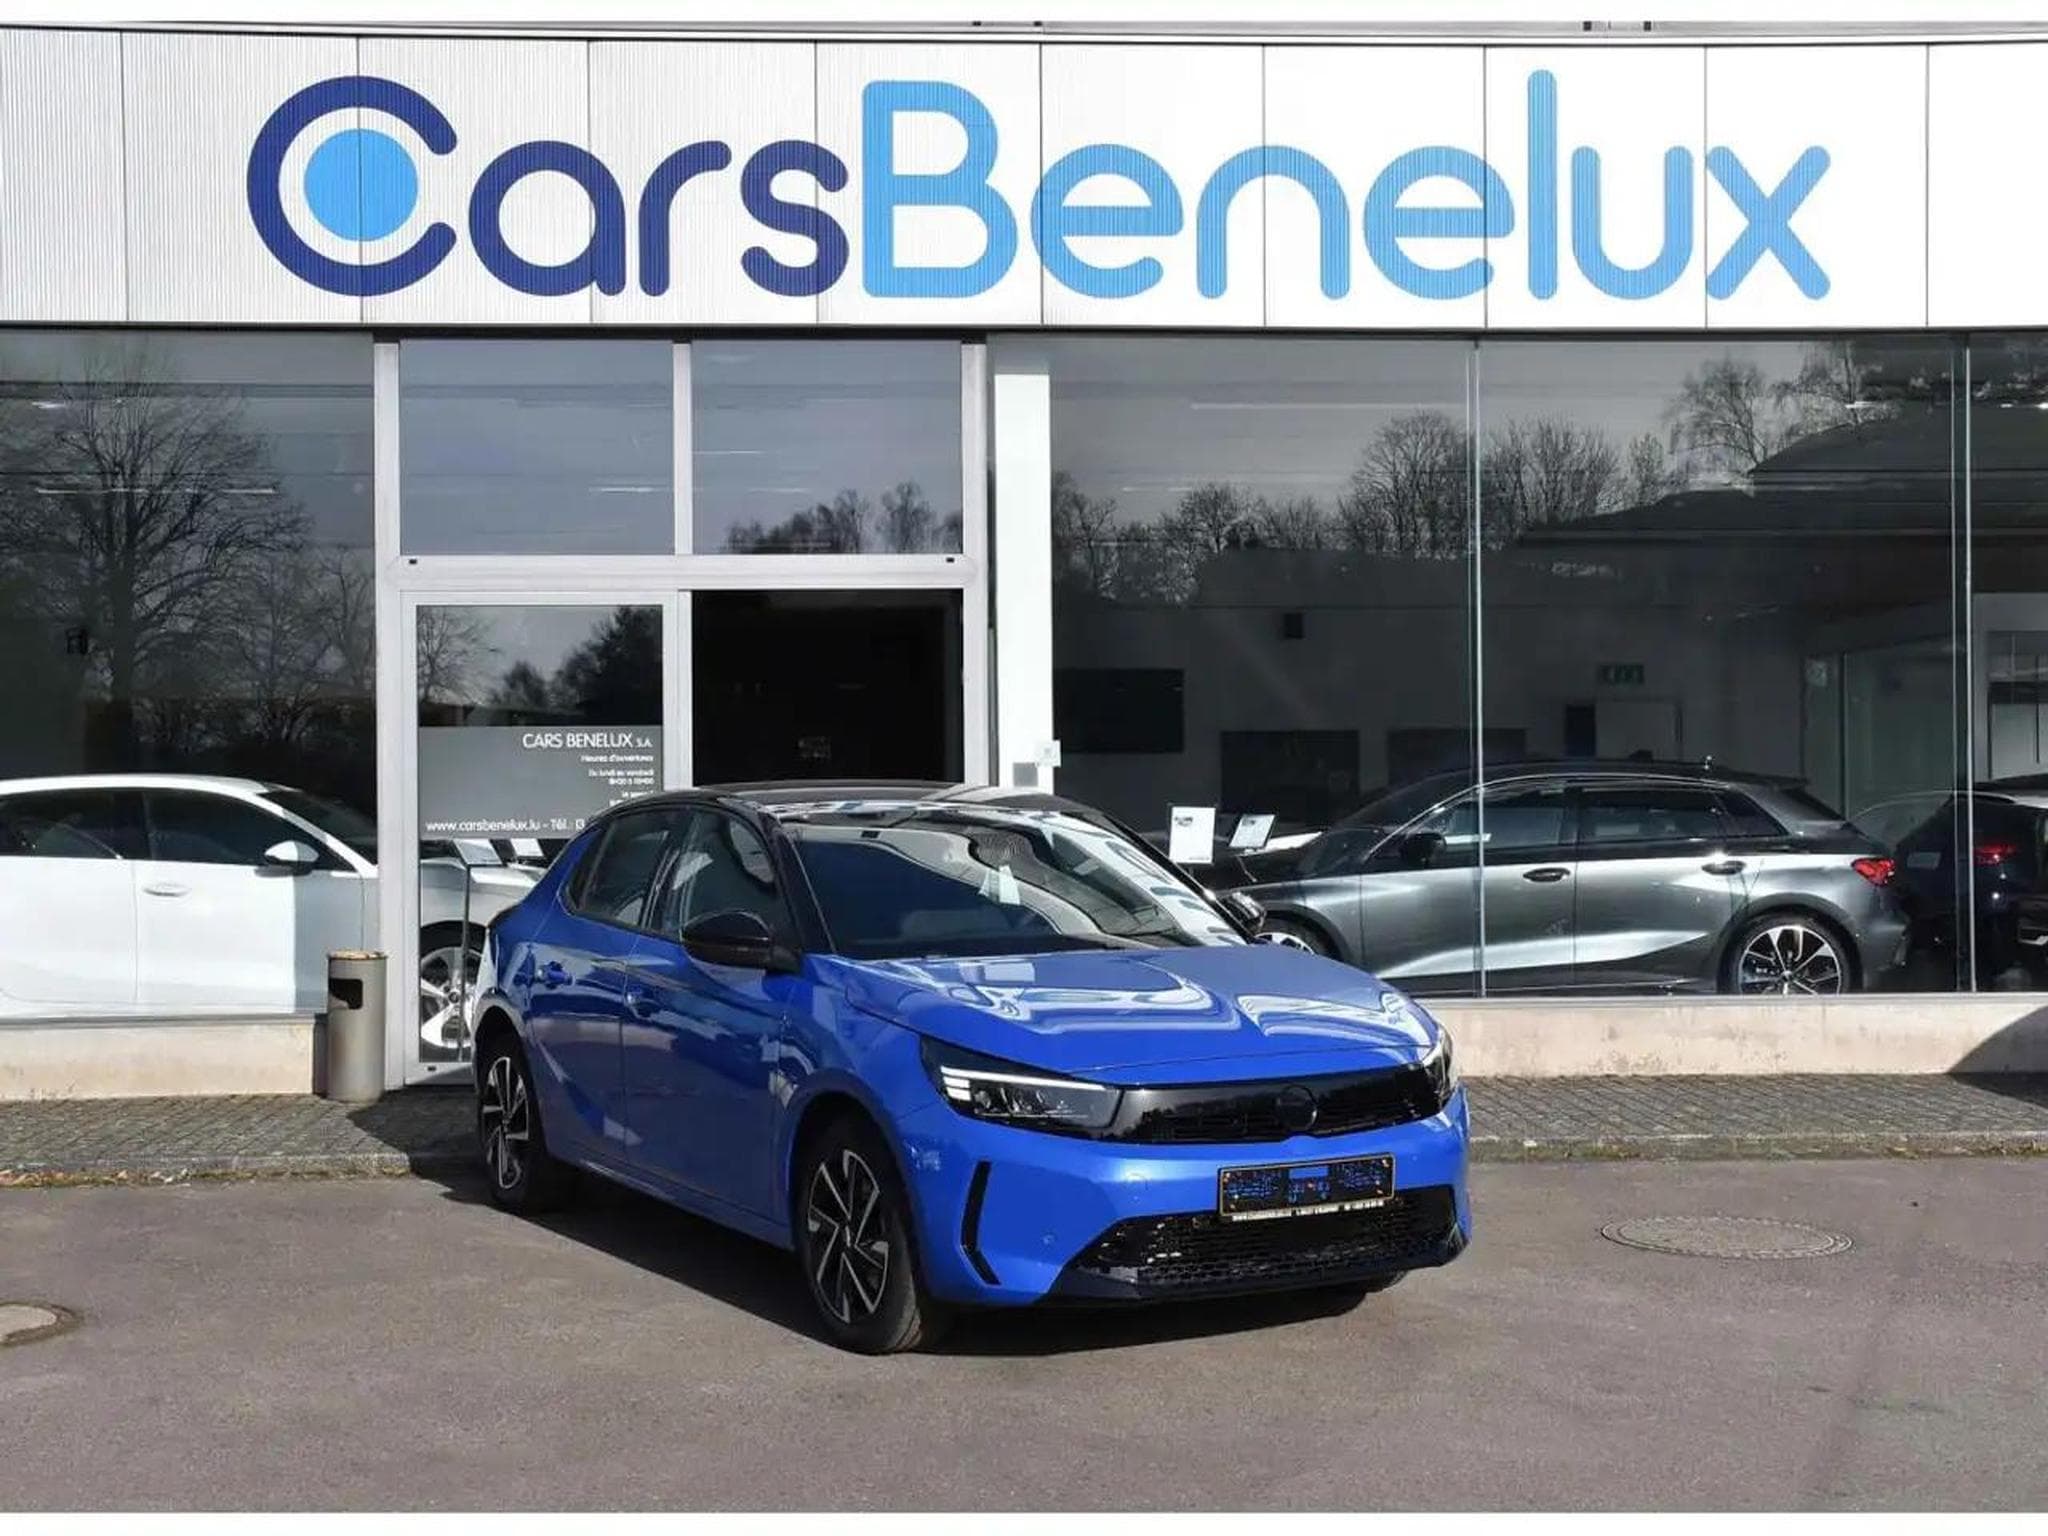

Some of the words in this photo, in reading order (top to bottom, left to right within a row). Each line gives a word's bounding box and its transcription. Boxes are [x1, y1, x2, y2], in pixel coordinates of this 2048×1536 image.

[247, 69, 1832, 301] CarsBenelux
[522, 732, 563, 749] CARS
[566, 732, 633, 749] BENELUX
[425, 818, 541, 832] www.carsbenelux.lu
